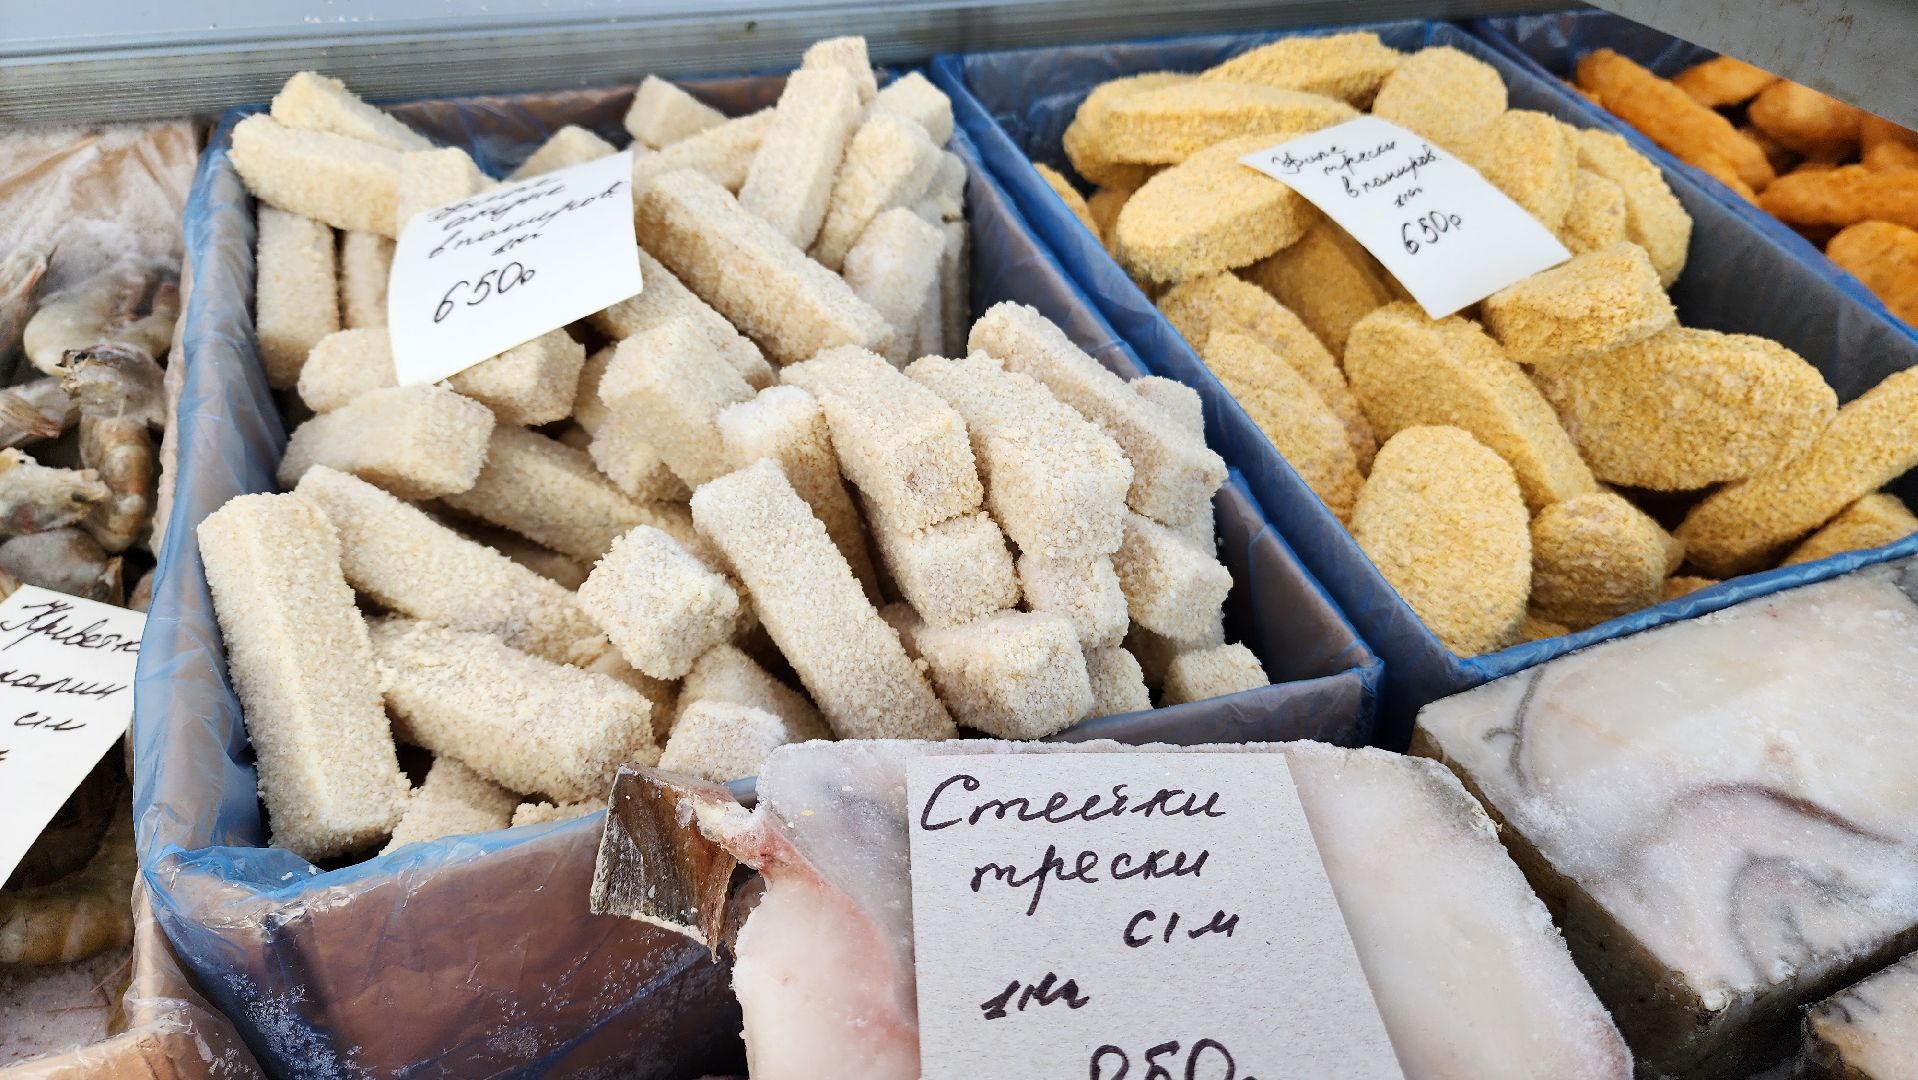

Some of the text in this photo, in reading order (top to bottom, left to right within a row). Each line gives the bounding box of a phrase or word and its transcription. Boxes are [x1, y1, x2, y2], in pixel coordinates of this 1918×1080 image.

[1322, 140, 1396, 177] трески
[1401, 210, 1463, 256] 650р
[921, 773, 1227, 831] Стейки
[970, 844, 1211, 917] трески
